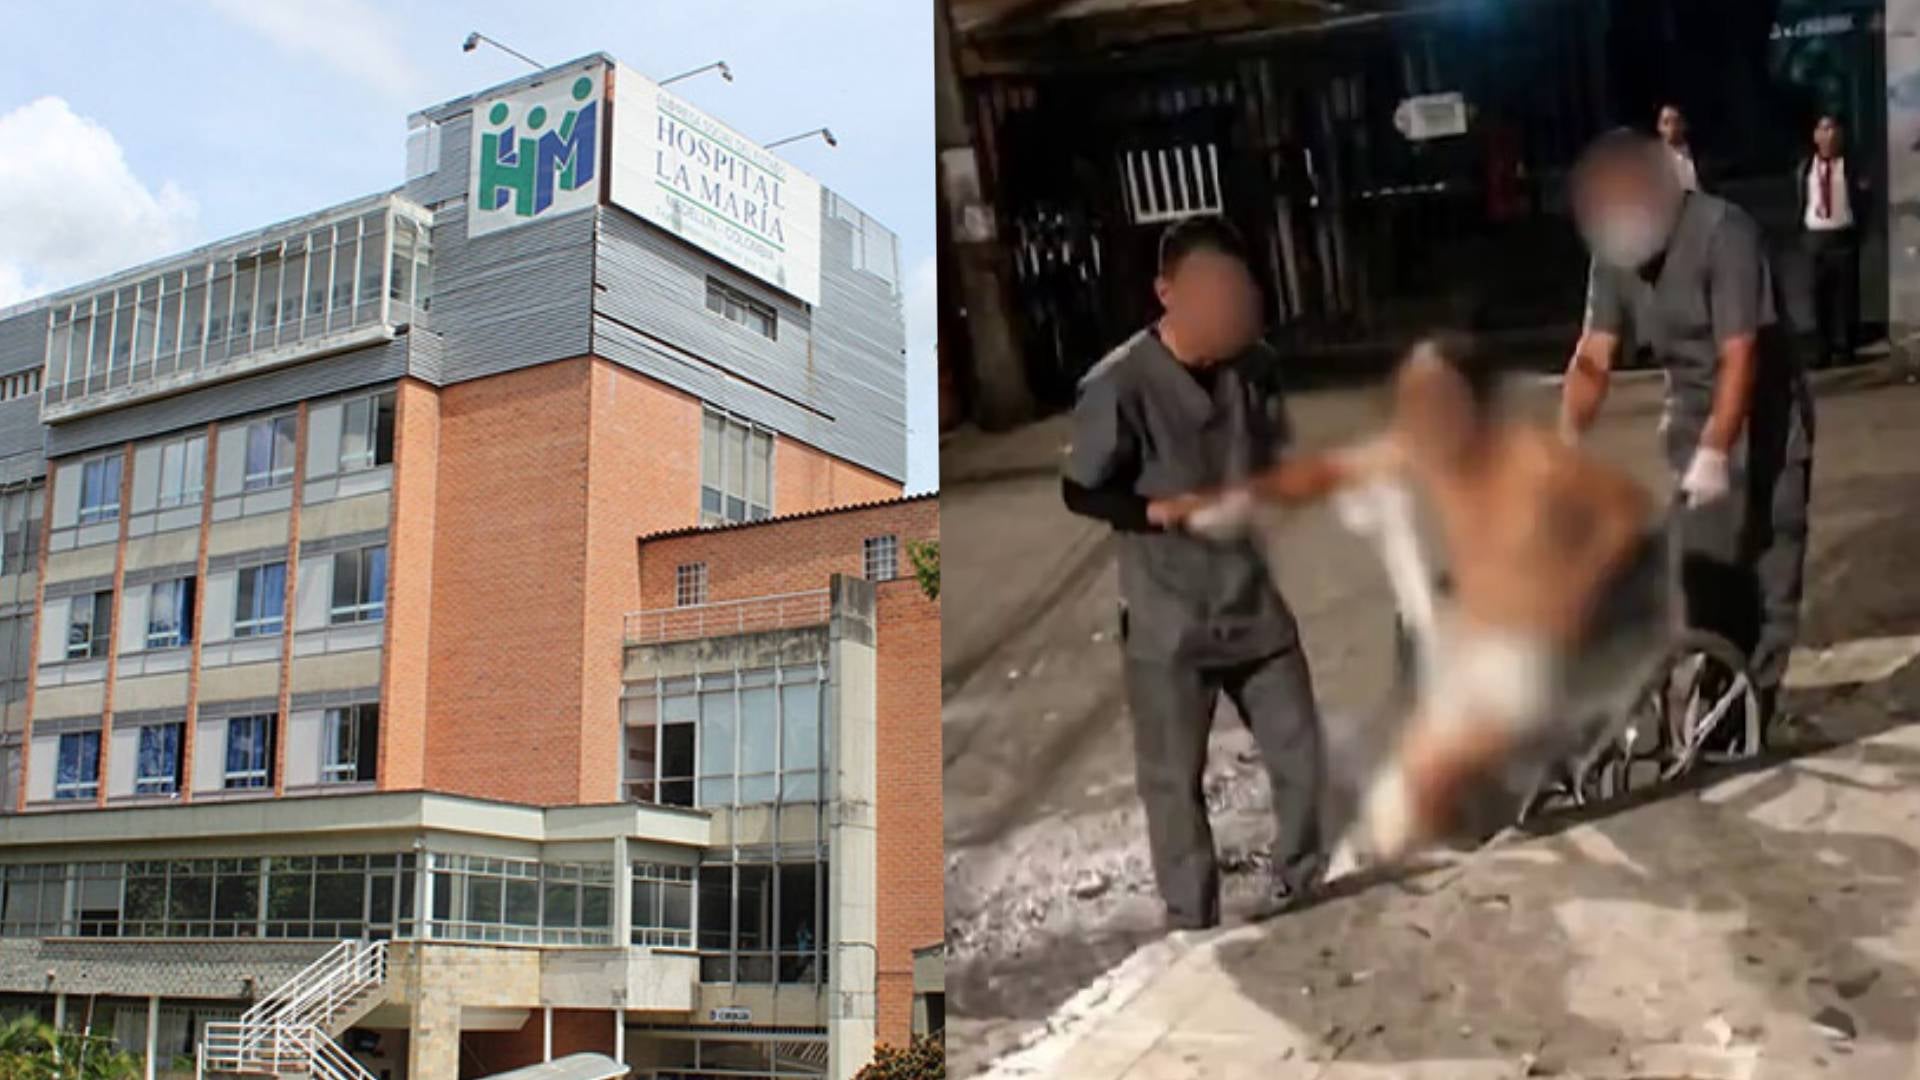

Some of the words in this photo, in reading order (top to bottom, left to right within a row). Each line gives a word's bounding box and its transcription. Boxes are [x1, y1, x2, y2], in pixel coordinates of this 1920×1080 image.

[656, 115, 785, 210] HOSPITAL
[656, 150, 691, 192] LA
[700, 174, 785, 243] MARÍA
